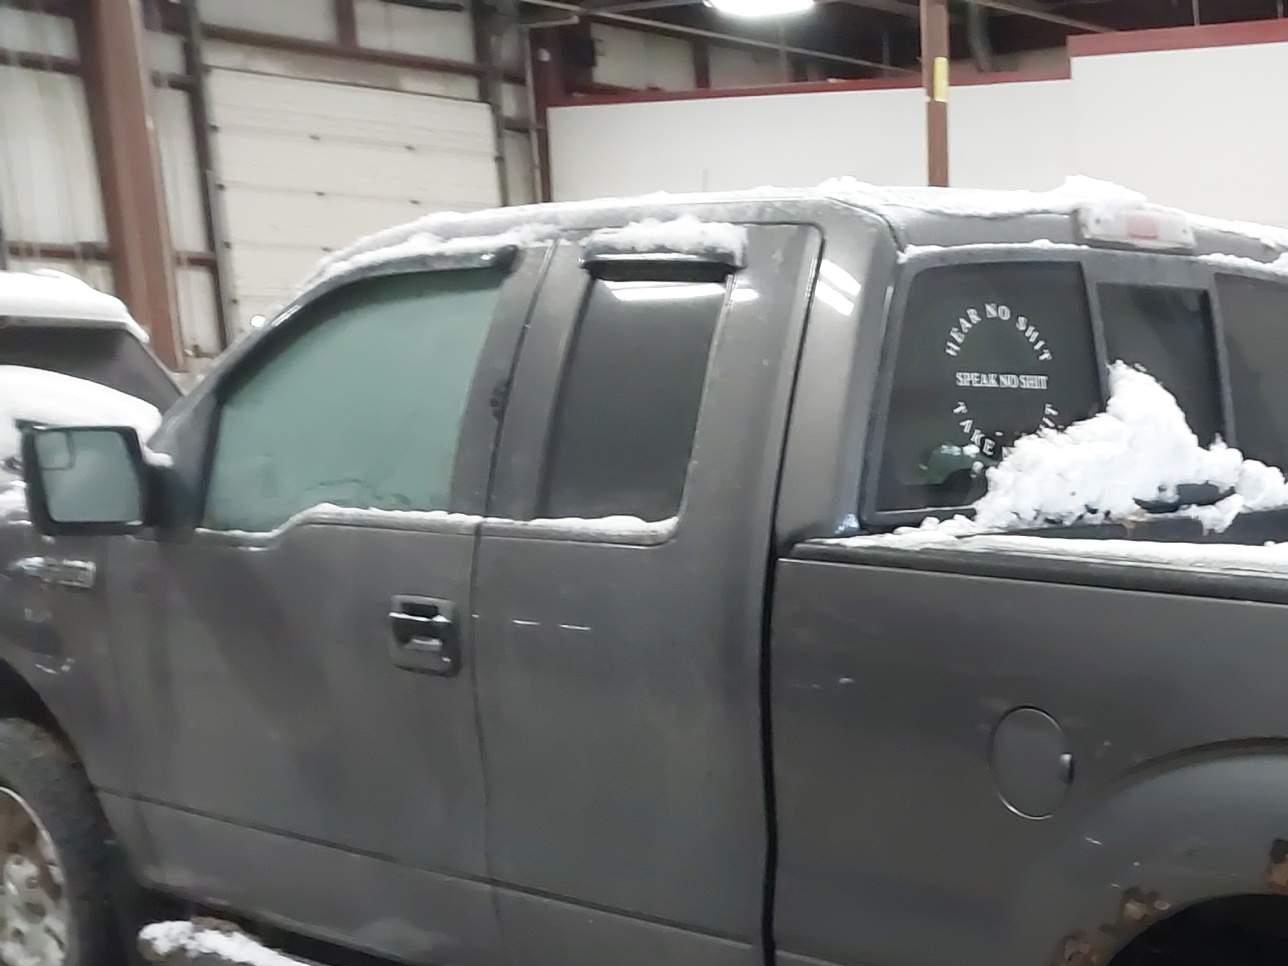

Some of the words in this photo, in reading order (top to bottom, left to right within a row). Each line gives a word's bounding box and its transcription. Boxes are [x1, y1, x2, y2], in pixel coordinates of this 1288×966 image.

[945, 308, 982, 357] HEAR
[984, 303, 1011, 321] NO
[1015, 316, 1053, 361] SHIT
[956, 372, 999, 387] SPEAK
[999, 374, 1019, 388] NO
[1019, 374, 1048, 389] SHIT
[953, 401, 996, 455] TAKE
